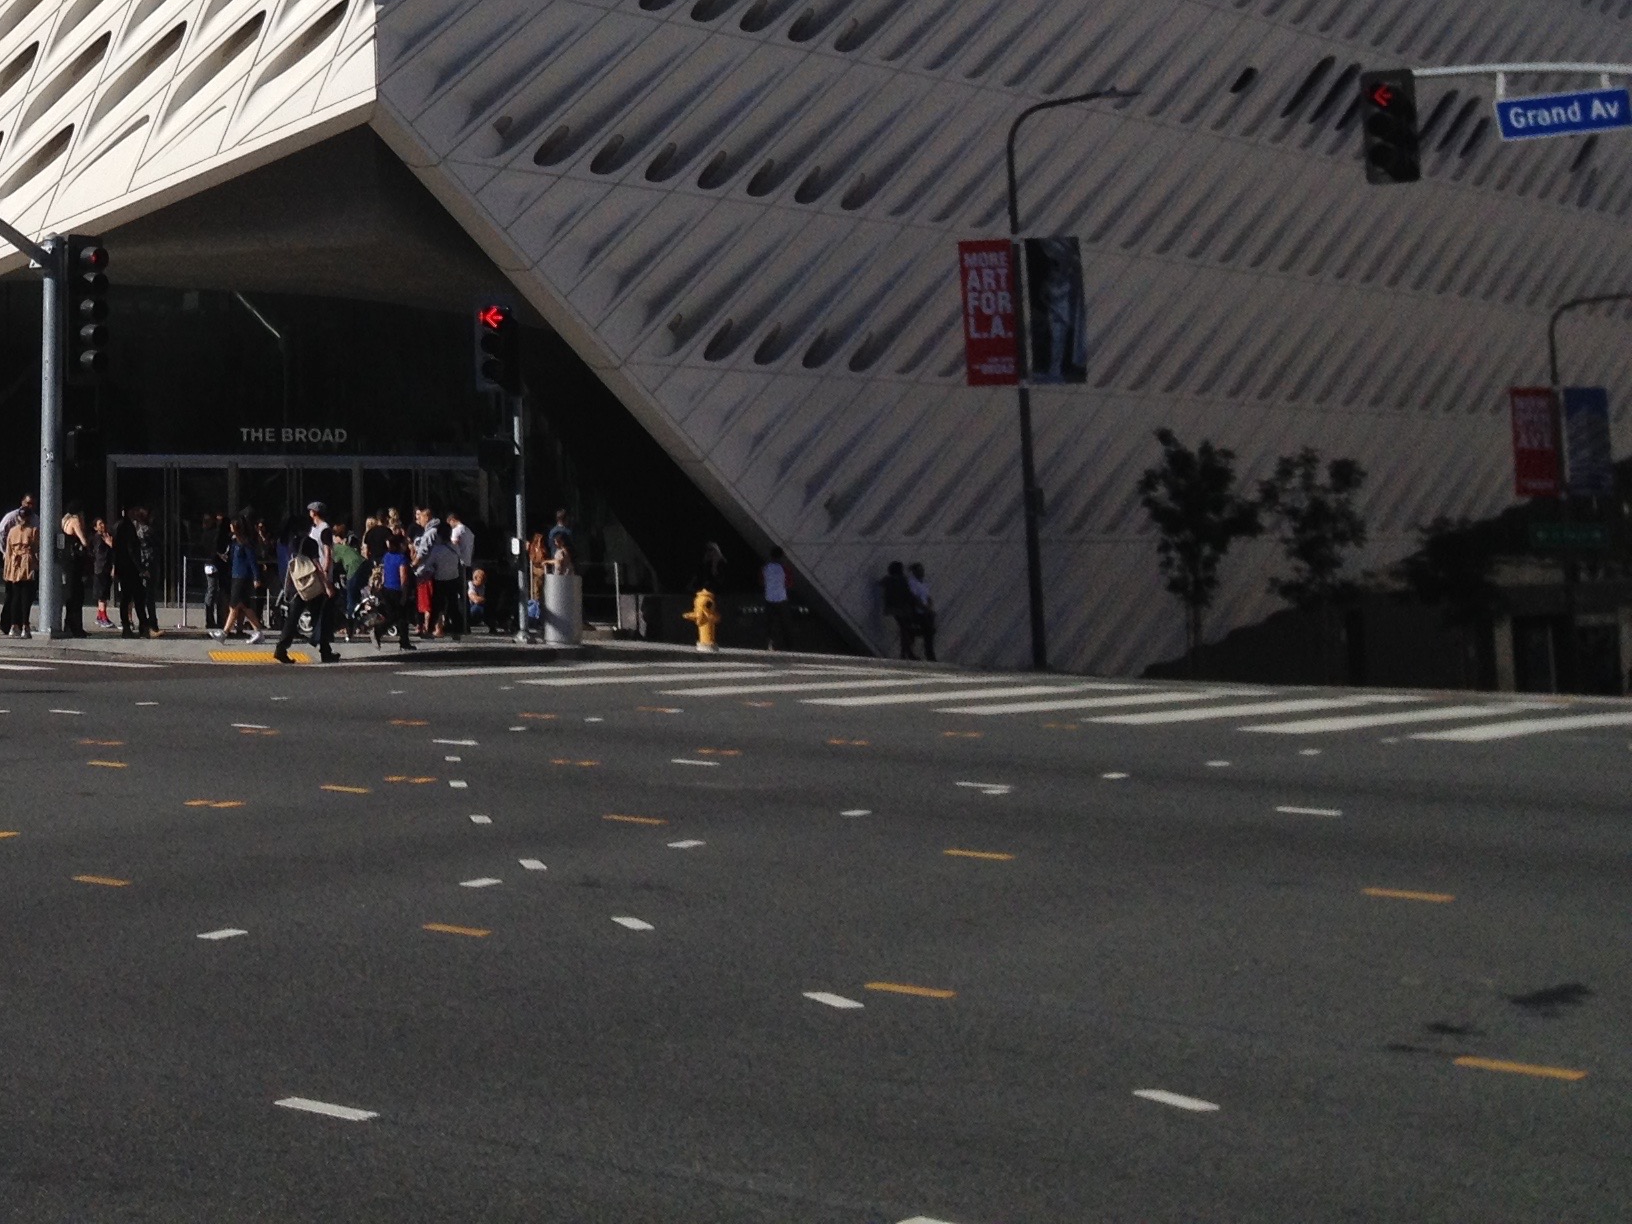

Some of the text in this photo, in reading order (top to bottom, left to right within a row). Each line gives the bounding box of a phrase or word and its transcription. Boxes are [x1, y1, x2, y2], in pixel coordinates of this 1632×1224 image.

[1509, 98, 1620, 129] Grand Av
[967, 268, 1009, 292] ART
[967, 291, 1012, 315] FOR
[969, 314, 1014, 338] L.A.
[239, 428, 348, 443] THE BROAD
